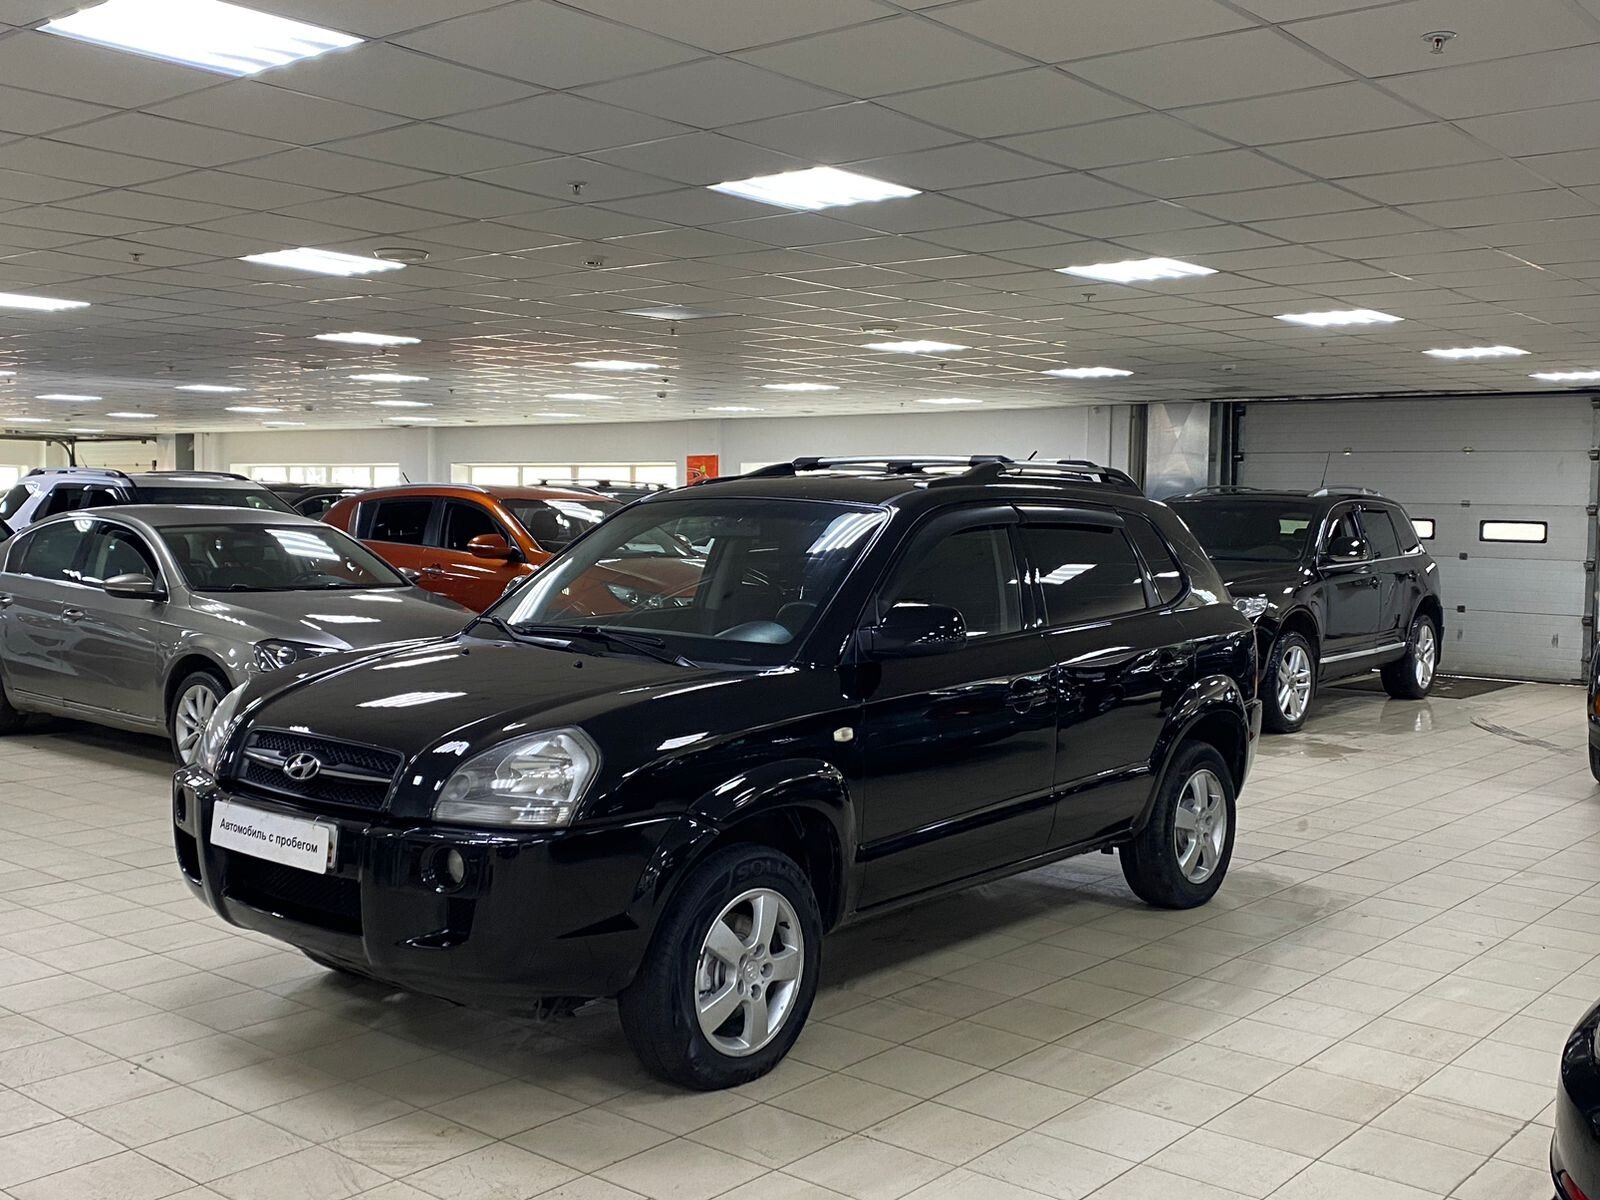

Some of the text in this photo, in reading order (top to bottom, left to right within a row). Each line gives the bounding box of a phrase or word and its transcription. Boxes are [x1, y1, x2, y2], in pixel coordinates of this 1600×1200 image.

[220, 818, 318, 853] Автомобиль с пробегом
